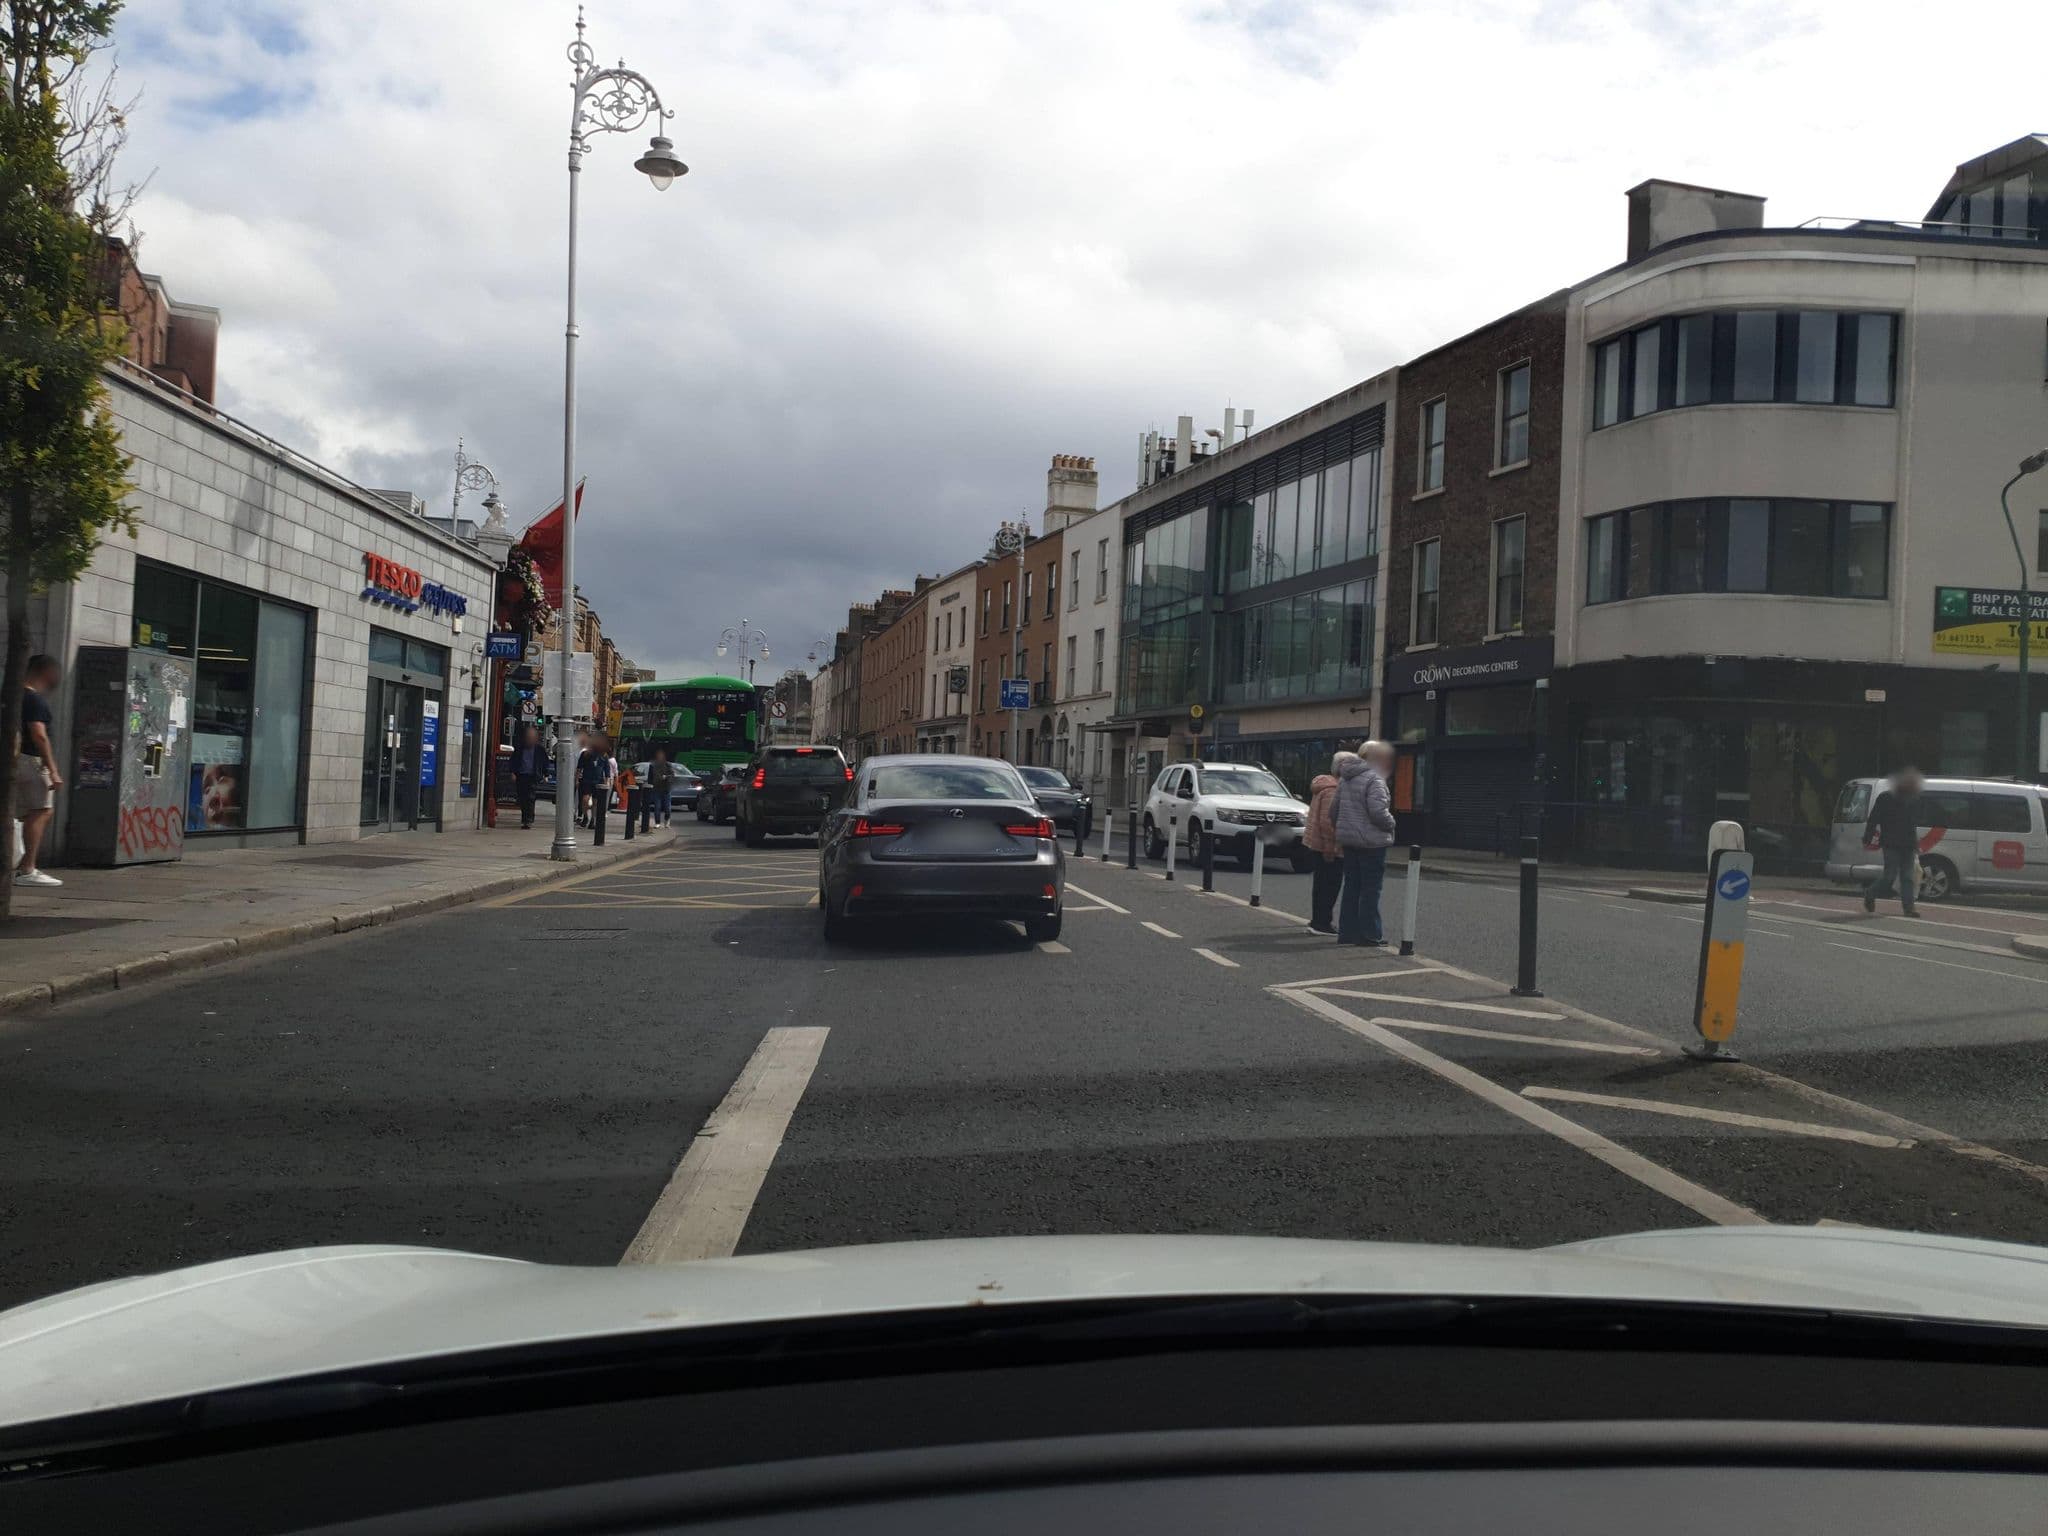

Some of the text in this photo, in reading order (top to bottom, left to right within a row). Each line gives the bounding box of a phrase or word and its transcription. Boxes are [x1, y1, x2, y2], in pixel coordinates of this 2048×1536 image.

[366, 551, 421, 598] TESCO
[1972, 593, 2048, 607] BNP PAIBA
[1972, 605, 2006, 616] REAL
[490, 642, 517, 655] ATM
[1413, 660, 1519, 685] CROWN DECORATING CENTRES
